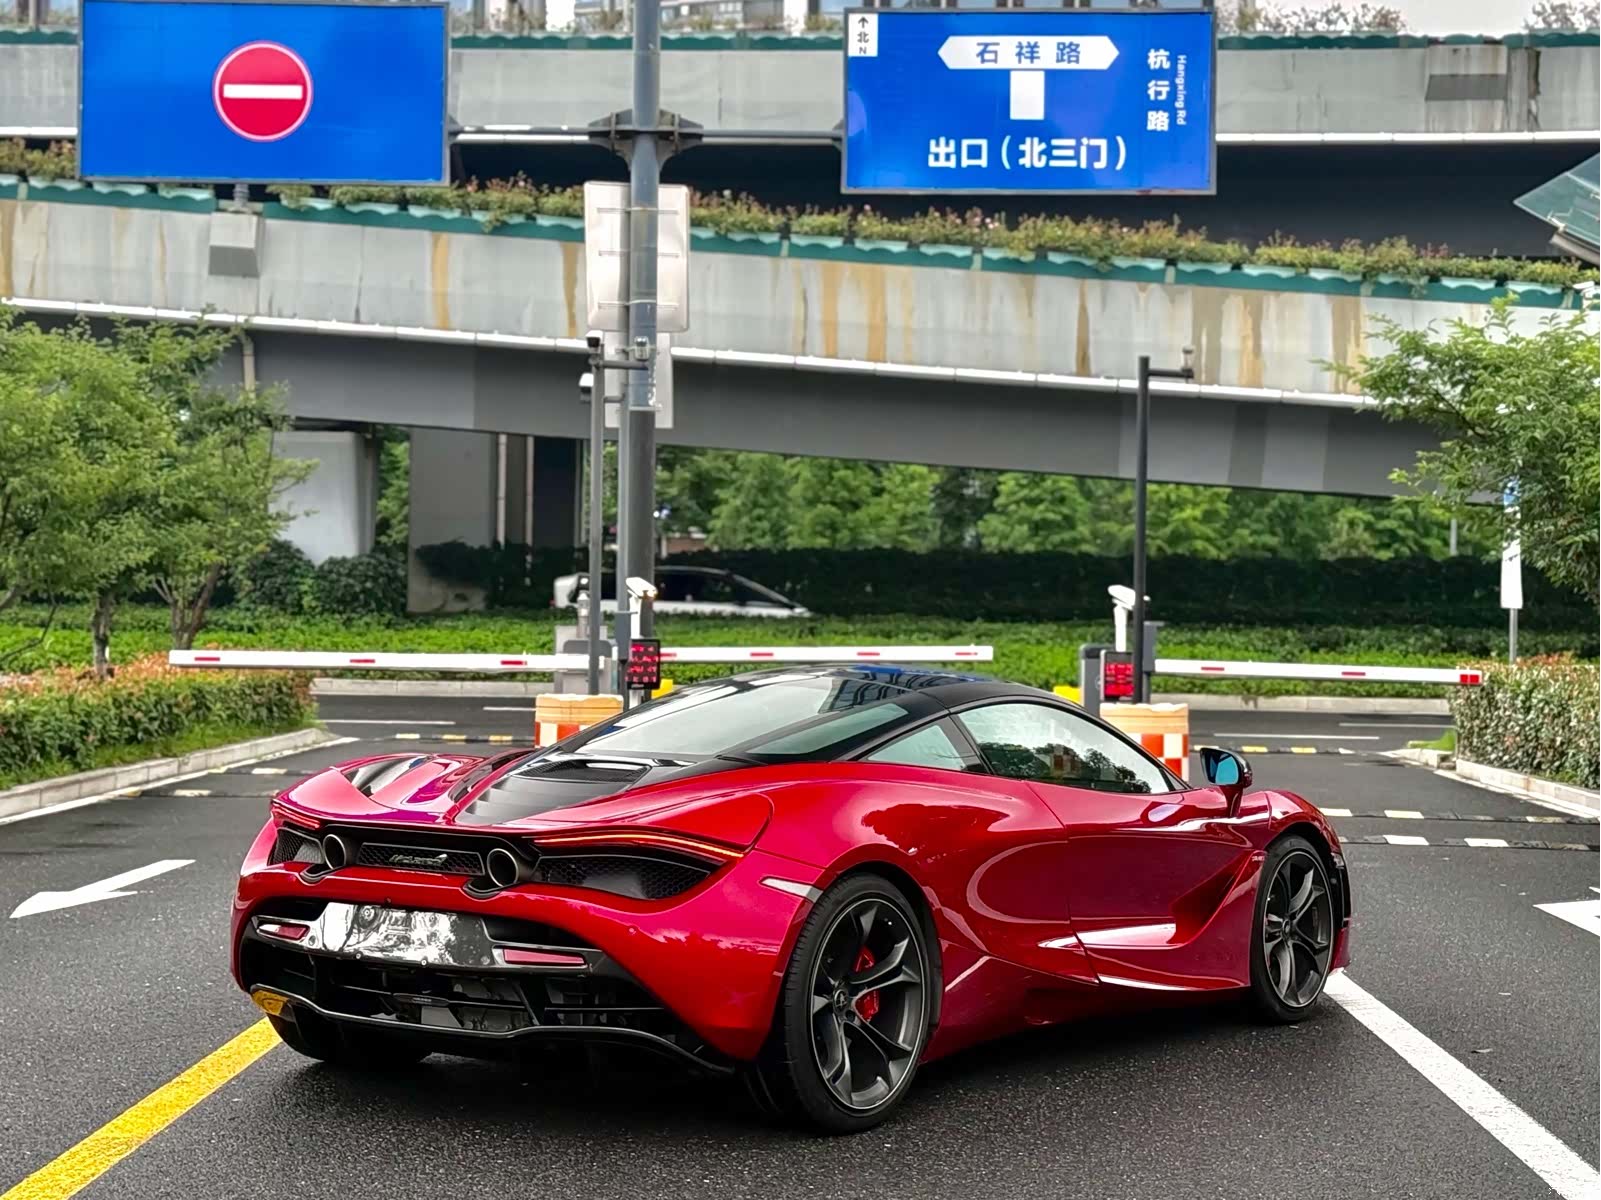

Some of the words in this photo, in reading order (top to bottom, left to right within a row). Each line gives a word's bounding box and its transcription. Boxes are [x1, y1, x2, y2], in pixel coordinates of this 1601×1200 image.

[857, 31, 870, 44] 北
[858, 46, 868, 55] N
[976, 41, 1081, 65] 石祥路
[1146, 48, 1171, 132] 杭行路
[1174, 54, 1187, 108] Hangxing
[1176, 109, 1187, 126] Rd
